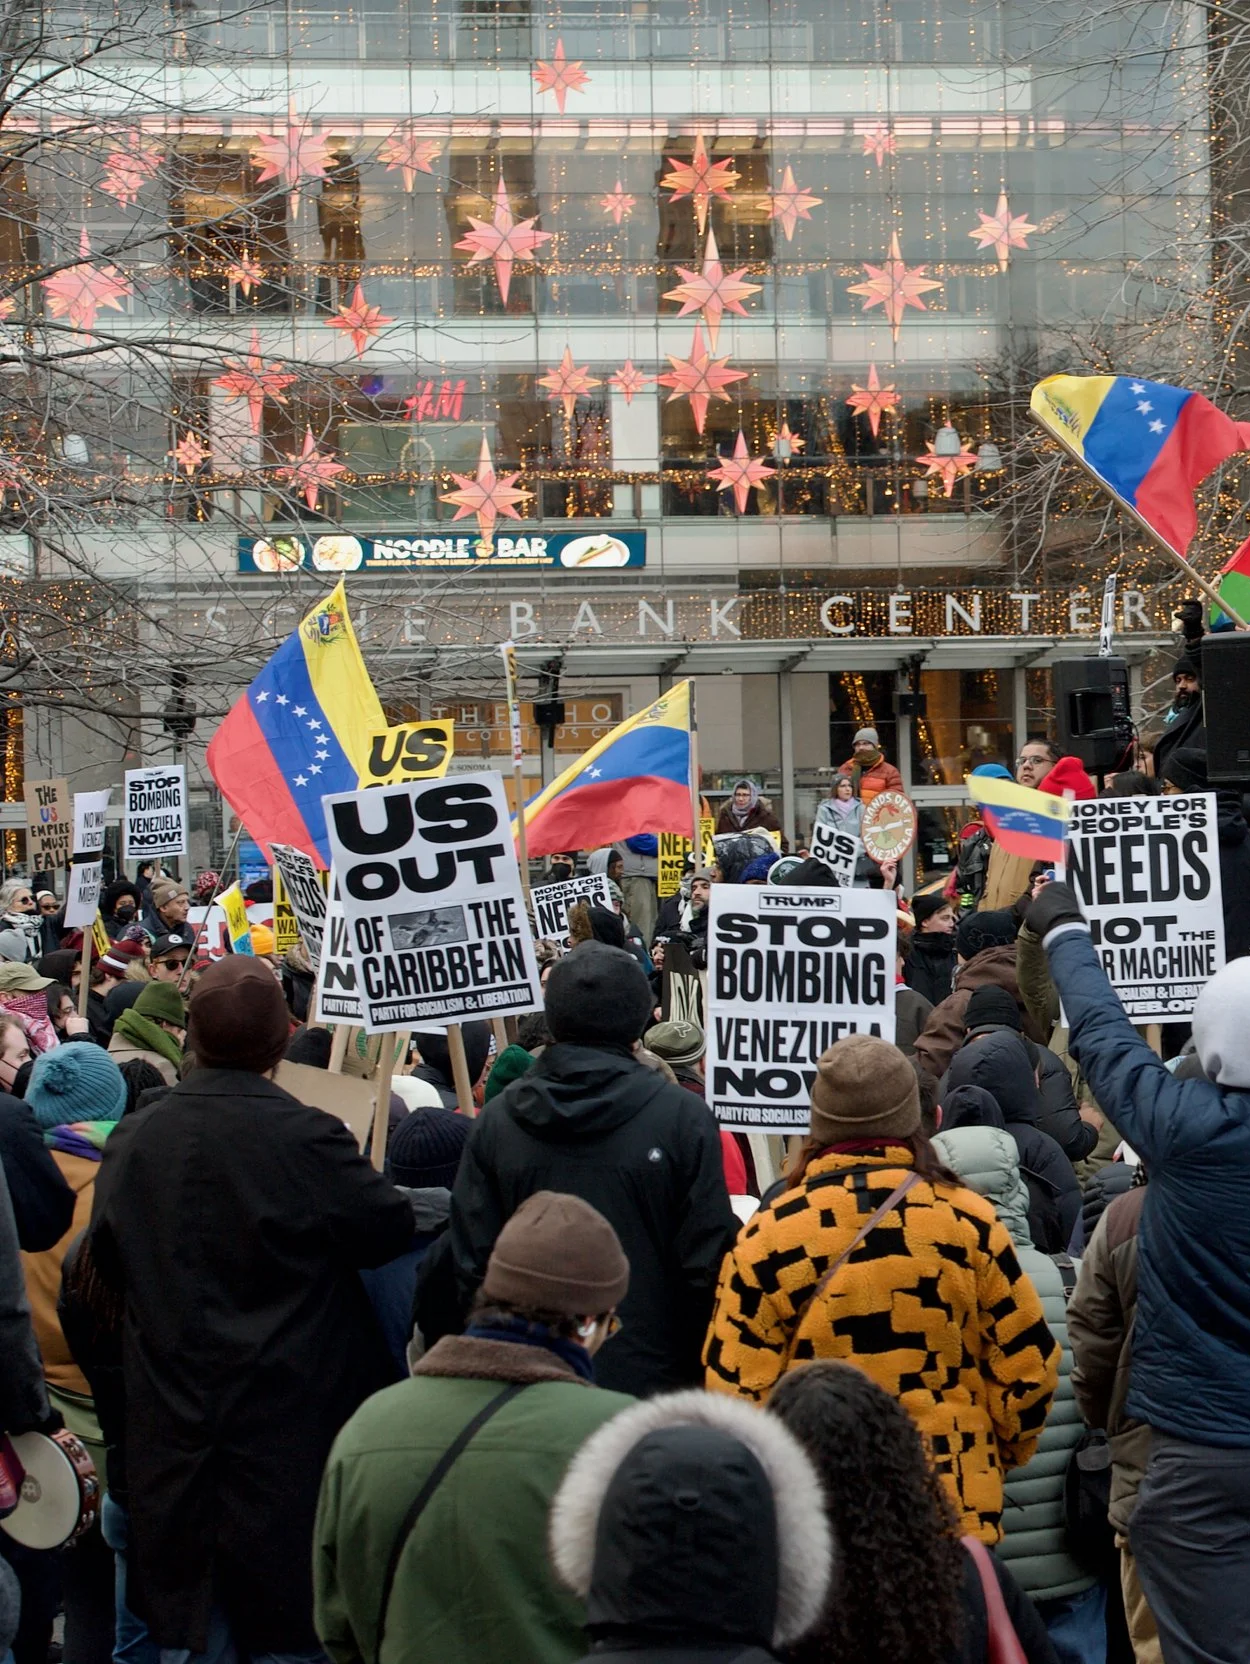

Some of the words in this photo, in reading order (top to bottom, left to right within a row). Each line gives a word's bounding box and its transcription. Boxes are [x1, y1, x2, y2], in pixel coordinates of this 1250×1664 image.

[373, 538, 470, 559] NOODLE
[498, 537, 548, 558] BAR
[509, 599, 741, 640] BANK
[820, 590, 1152, 635] CENTER
[432, 706, 506, 727] THE
[368, 727, 448, 777] US
[129, 776, 180, 791] STOP
[35, 784, 57, 806] THE
[129, 788, 181, 812] BOMBING
[1157, 797, 1207, 813] FOR
[40, 807, 58, 823] US
[332, 783, 498, 856] US
[863, 792, 892, 825] HANDS
[894, 794, 913, 815] OFF
[30, 822, 70, 838] EMPIRE
[83, 811, 94, 829] NO
[129, 814, 182, 833] VENEZUELA
[1067, 812, 1208, 835] PEOPLE'S
[41, 835, 69, 851] MUST
[129, 831, 182, 845] NOW!
[816, 825, 855, 856] US
[33, 849, 69, 871] FALL
[813, 845, 853, 869] OUT
[1066, 830, 1211, 906] NEEDS
[81, 867, 91, 884] NO
[345, 843, 506, 901] OUT
[534, 879, 578, 896] MONEY
[578, 875, 603, 886] FOR
[535, 883, 604, 904] PEOPLE'S
[762, 895, 836, 908] TRUMP
[354, 915, 384, 955] OF
[468, 898, 520, 939] THE
[715, 912, 889, 948] STOP
[1179, 930, 1216, 941] THE
[362, 937, 528, 1000] CARIBBEAN
[1120, 944, 1217, 980] MACHINE
[715, 947, 886, 1006] BOMBING
[1157, 985, 1169, 999] &
[323, 998, 344, 1013] PARTY
[344, 1000, 357, 1014] FOR
[371, 1005, 399, 1022] PARTY
[400, 1003, 417, 1018] FOR
[417, 997, 465, 1017] SOCIALISM
[465, 996, 478, 1010] &
[477, 987, 531, 1008] LIBERATION
[715, 1105, 742, 1121] PARTY
[743, 1107, 761, 1123] FOR
